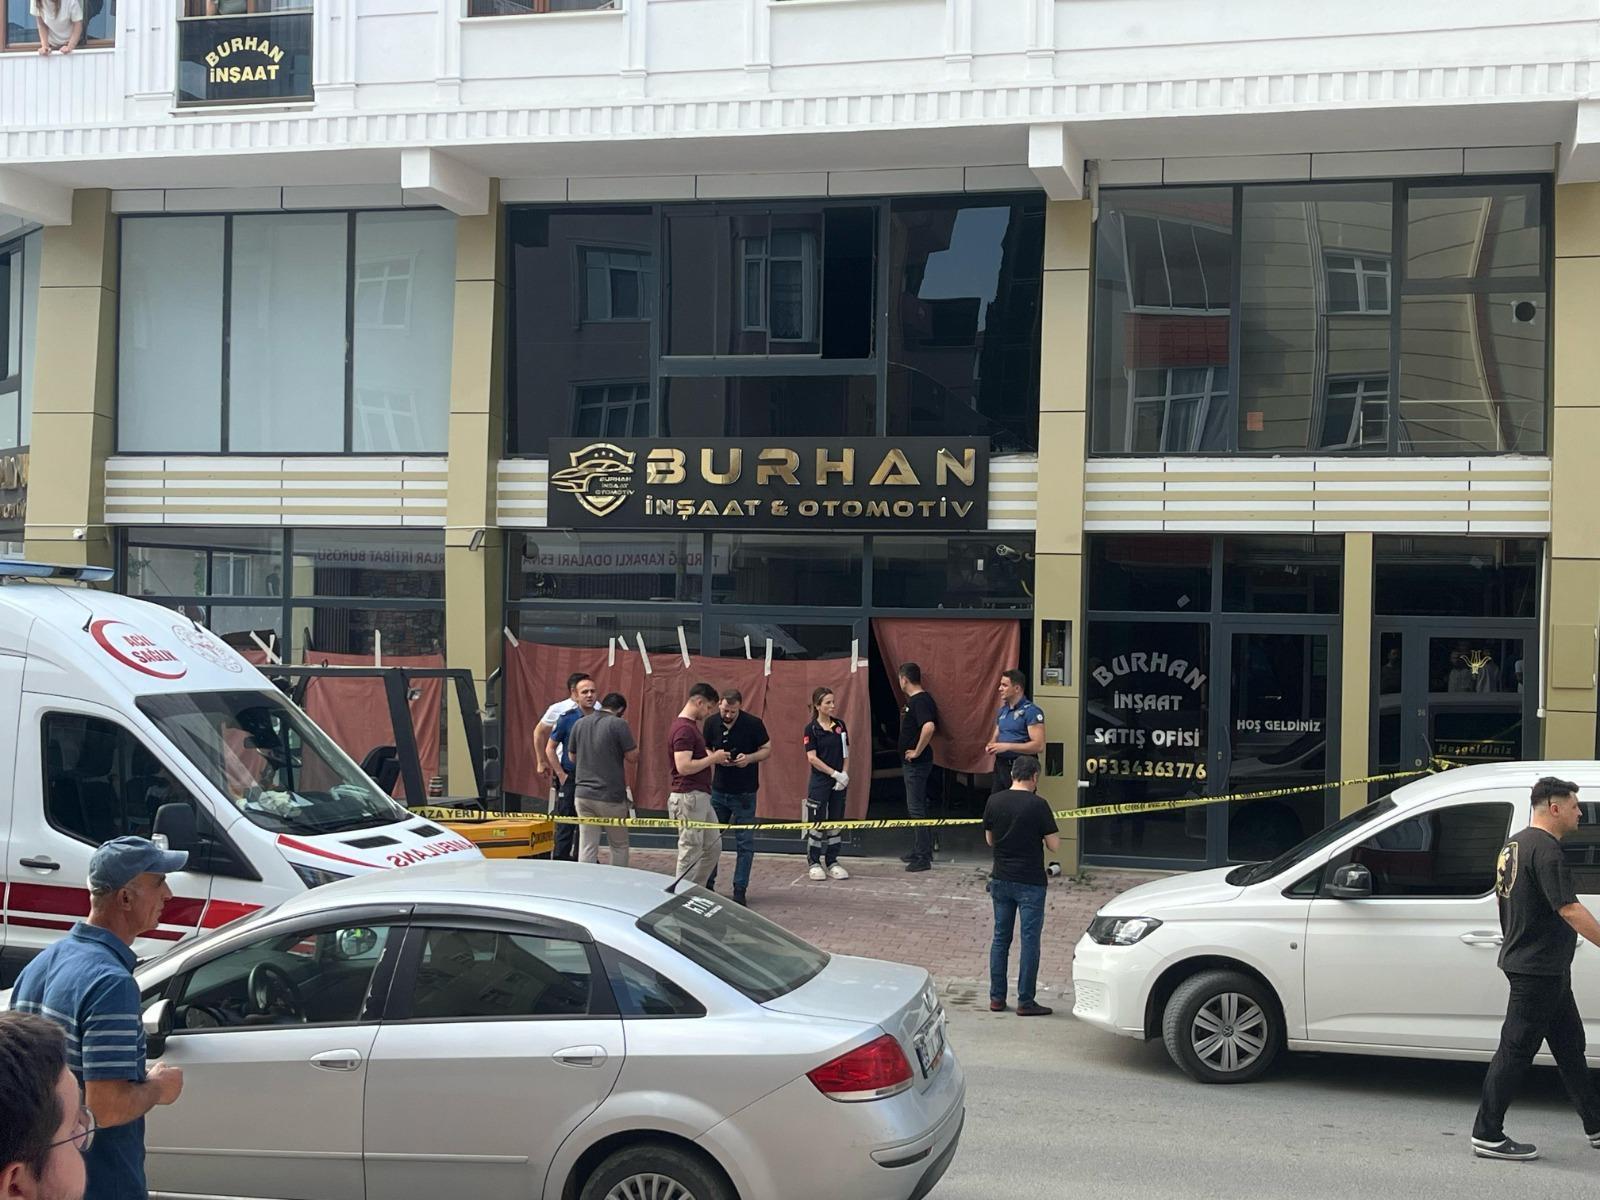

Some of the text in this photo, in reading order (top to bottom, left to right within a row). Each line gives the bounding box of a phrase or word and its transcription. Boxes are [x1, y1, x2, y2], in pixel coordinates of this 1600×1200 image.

[205, 36, 284, 67] BURHAN
[646, 448, 976, 486] BURHAN
[645, 495, 974, 520] İNŞAAT & OTOMOTİV
[132, 648, 180, 664] SAĞLIK
[1092, 652, 1207, 691] BURHAN
[1113, 690, 1183, 714] İNŞAAT
[1094, 727, 1200, 749] SATIŞ OFİSİ
[1237, 719, 1321, 733] HOŞ GELDİNİZ
